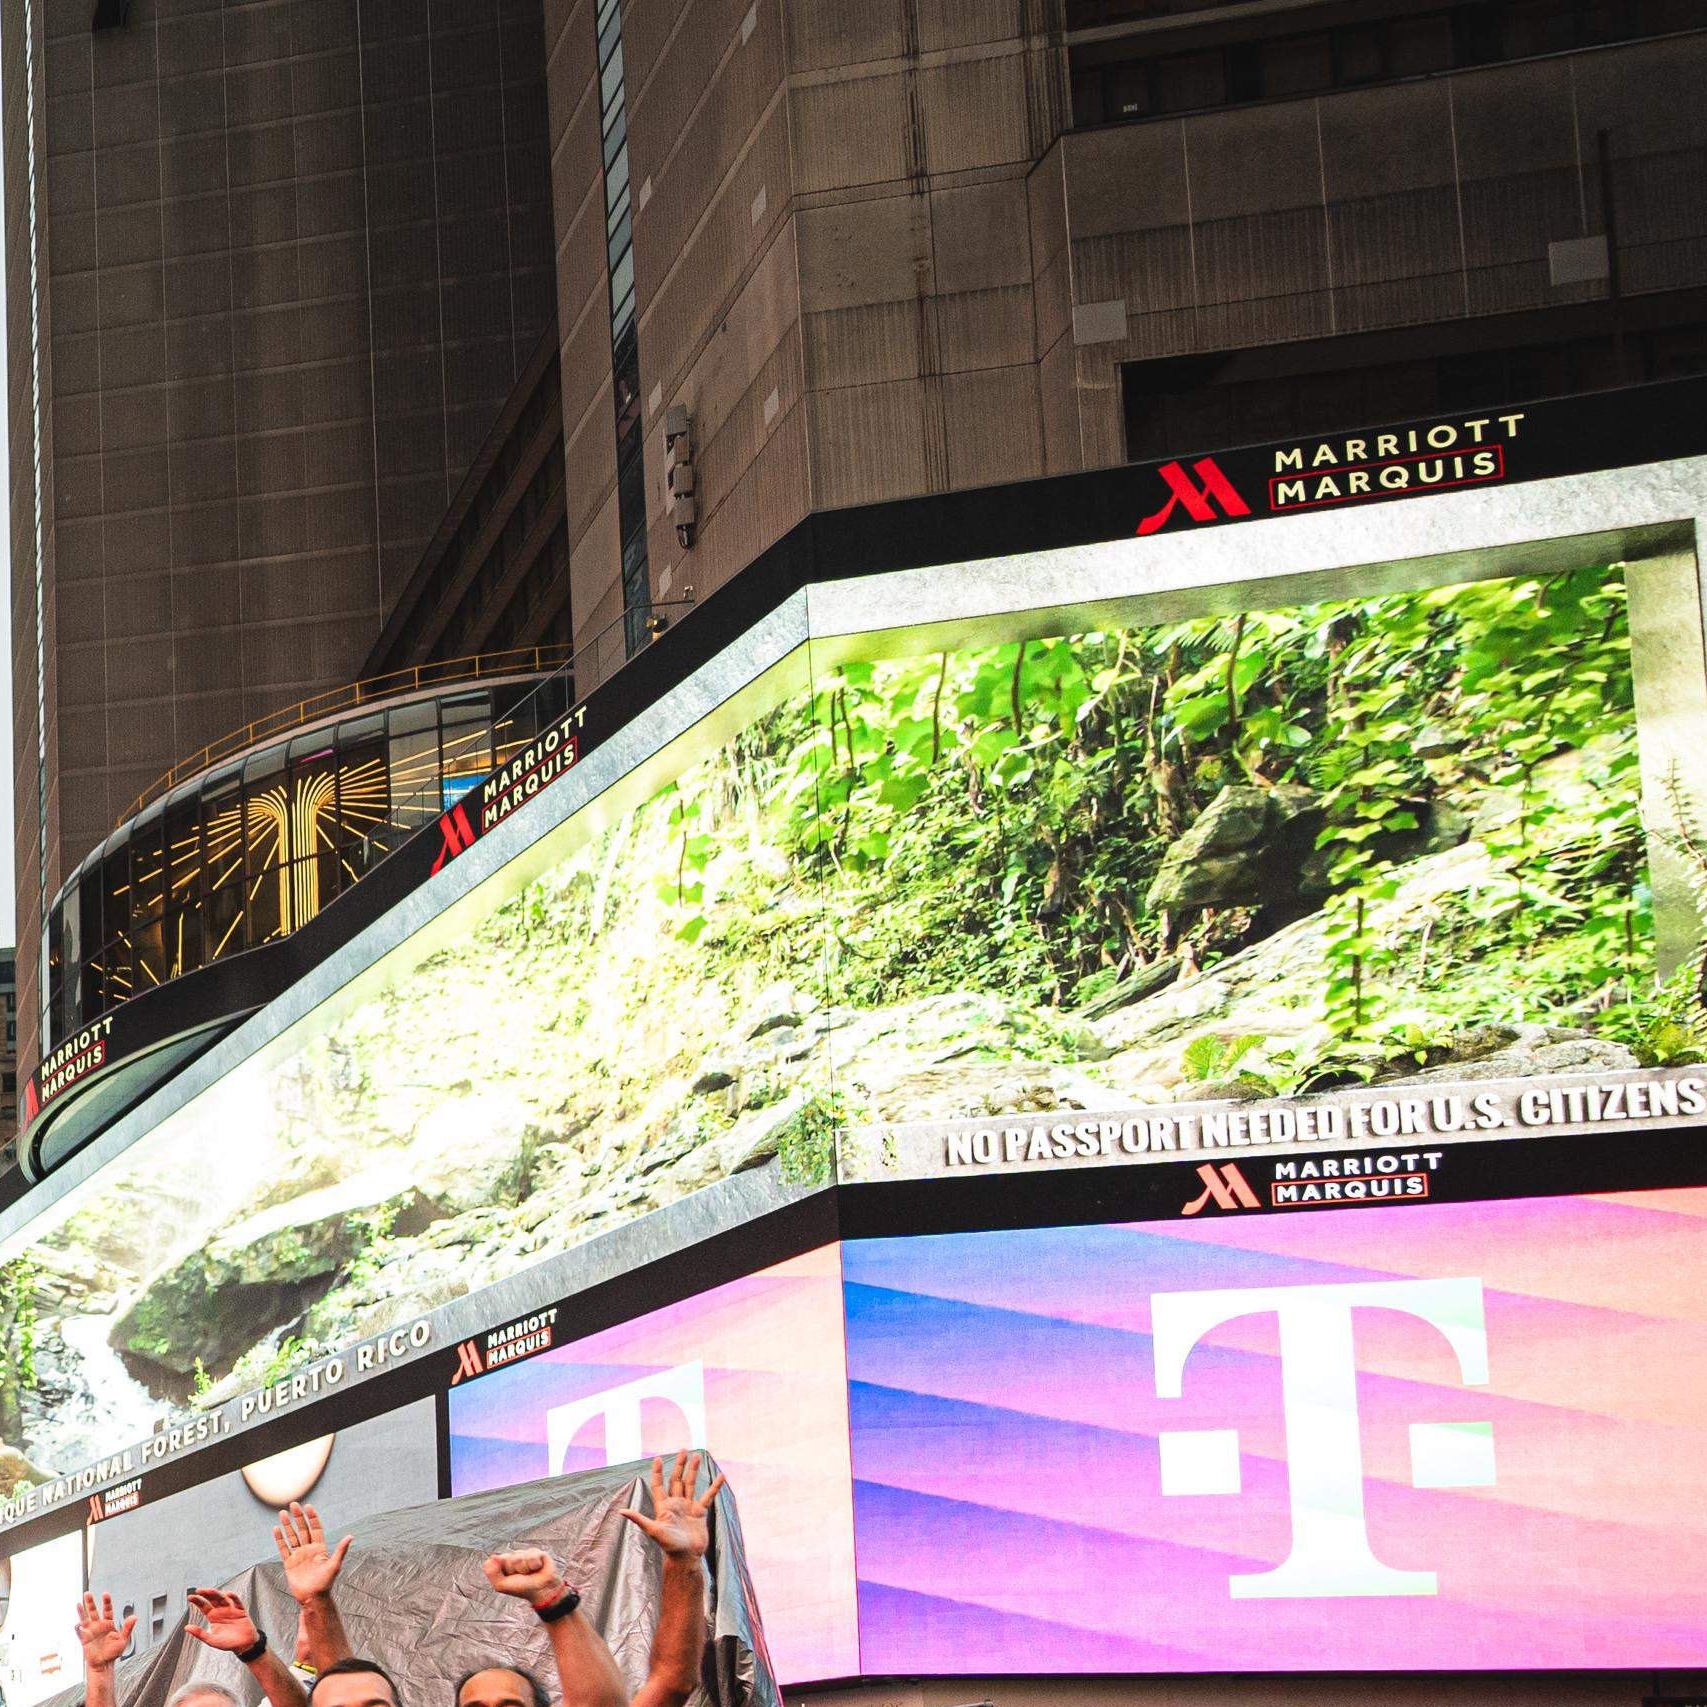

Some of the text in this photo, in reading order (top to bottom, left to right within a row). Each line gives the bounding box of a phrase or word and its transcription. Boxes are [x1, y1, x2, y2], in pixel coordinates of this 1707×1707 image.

[1275, 413, 1525, 473] MARRIOTT
[1277, 453, 1496, 506] MARQUIS
[484, 706, 588, 803] MARRIOTT
[484, 742, 577, 828] MARQUIS
[41, 1016, 114, 1081] MARRIOTT
[41, 1043, 105, 1103] MARQUIS
[946, 1080, 1705, 1168] NO PASSPORT NEEDED FOR U.S. CITIZENS
[1274, 1152, 1444, 1178] MARRIOTT
[1276, 1174, 1425, 1200] MARQUIS
[487, 1308, 558, 1347] MARRIOTT
[487, 1328, 551, 1366] MARQUIS
[42, 1456, 134, 1505] NATIONAL
[141, 1409, 232, 1465] FOREST,
[241, 1355, 344, 1421] PUERTO
[357, 1319, 431, 1372] RICO
[1150, 1277, 1496, 1600] T
[105, 1479, 142, 1500] MARRIOTT
[105, 1492, 139, 1514] MARQUIS
